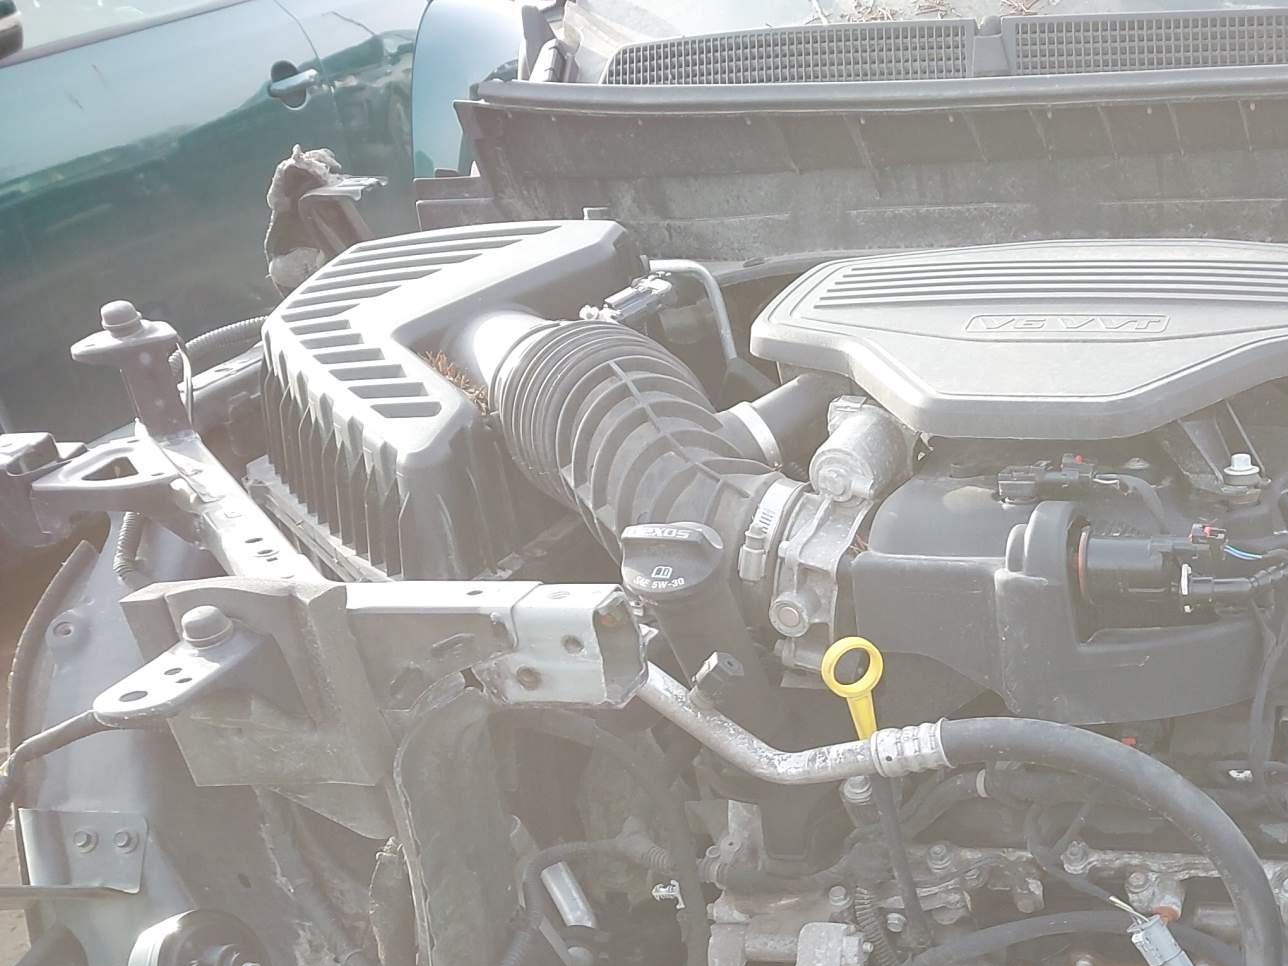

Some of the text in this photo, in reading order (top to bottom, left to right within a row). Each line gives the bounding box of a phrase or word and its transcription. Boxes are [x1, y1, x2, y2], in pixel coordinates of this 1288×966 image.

[980, 317, 1162, 330] V6 VVT
[652, 577, 685, 589] 5W-30
